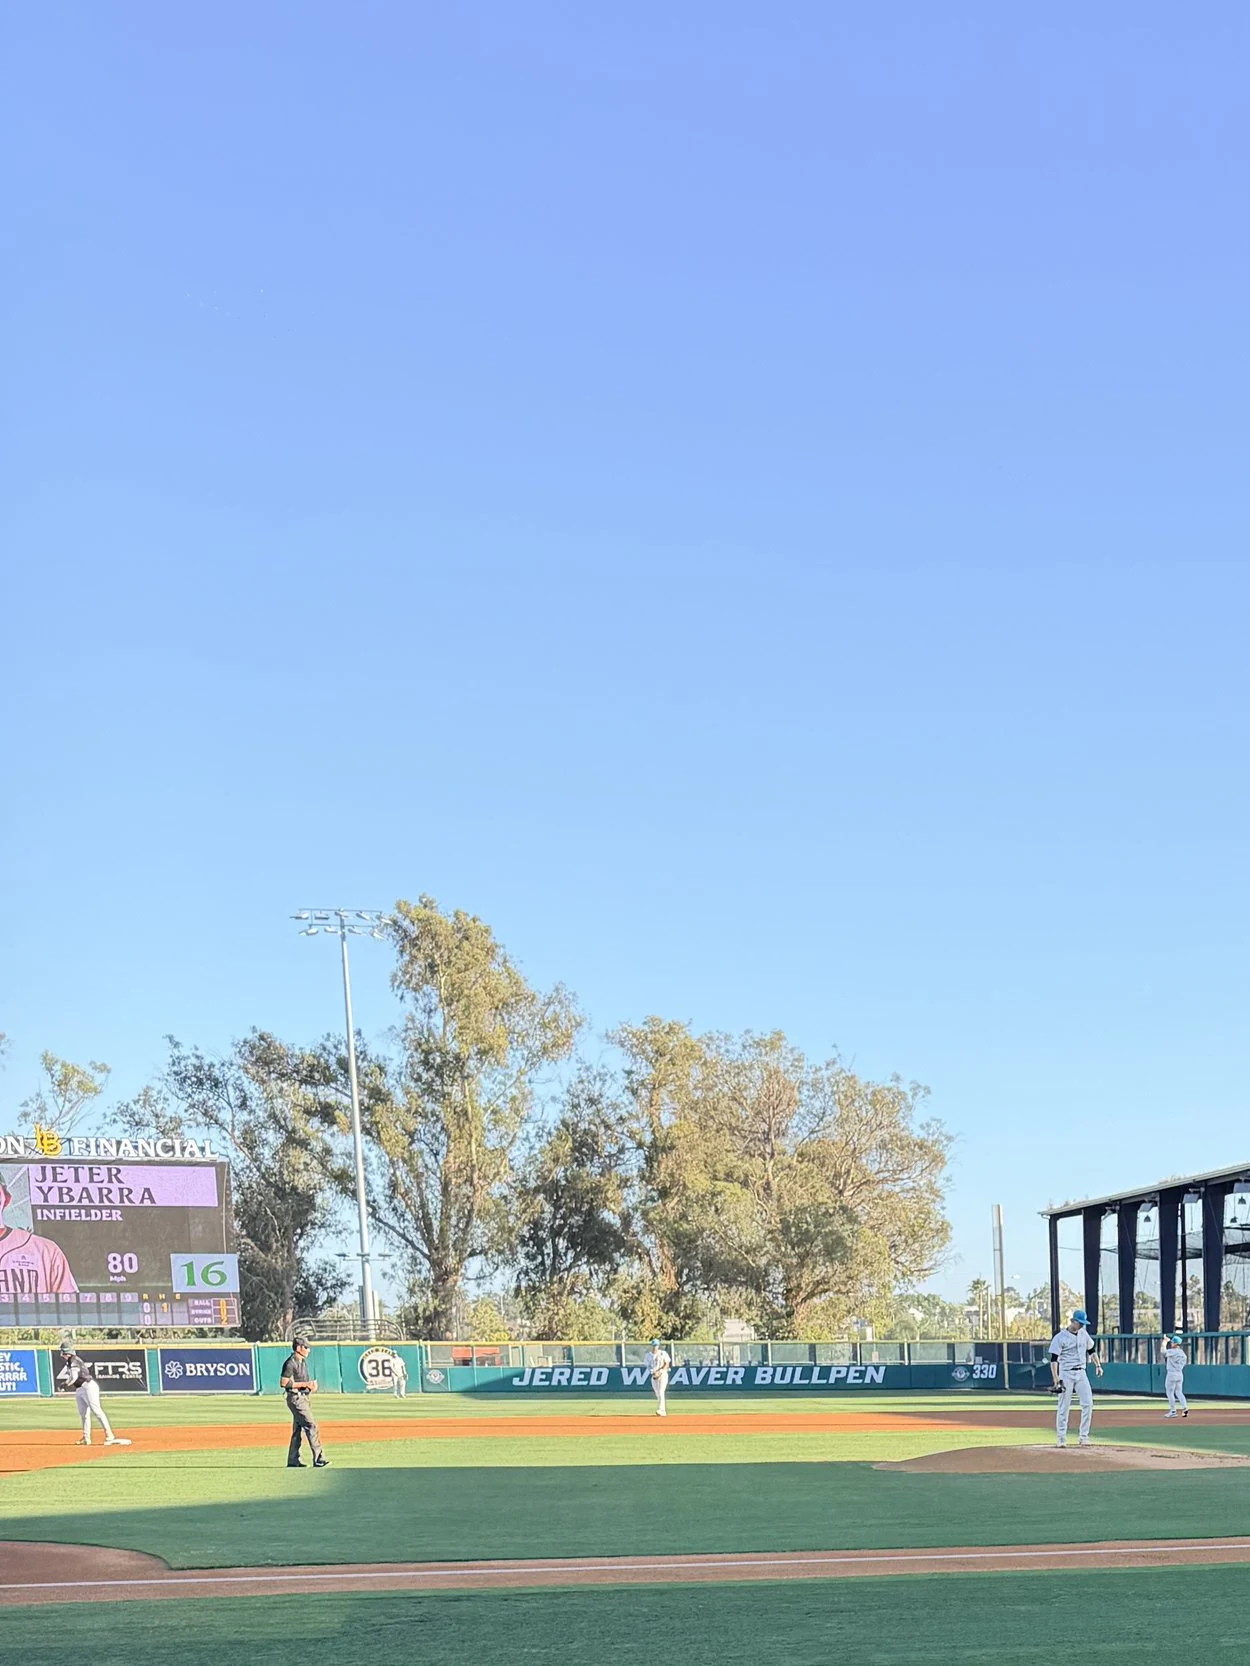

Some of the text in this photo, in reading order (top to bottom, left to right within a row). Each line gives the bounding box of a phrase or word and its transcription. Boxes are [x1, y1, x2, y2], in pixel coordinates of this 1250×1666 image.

[71, 1137, 219, 1158] FINANCIAL
[35, 1166, 125, 1184] JETER
[35, 1186, 157, 1205] YBARRA
[36, 1209, 123, 1221] INFIELDER
[107, 1252, 139, 1274] 80
[181, 1260, 227, 1287] 16
[185, 1363, 250, 1376] BRYSON
[368, 1360, 392, 1377] 36
[512, 1366, 887, 1386] JERED WAVER BULLPEN
[972, 1364, 997, 1379] 330
